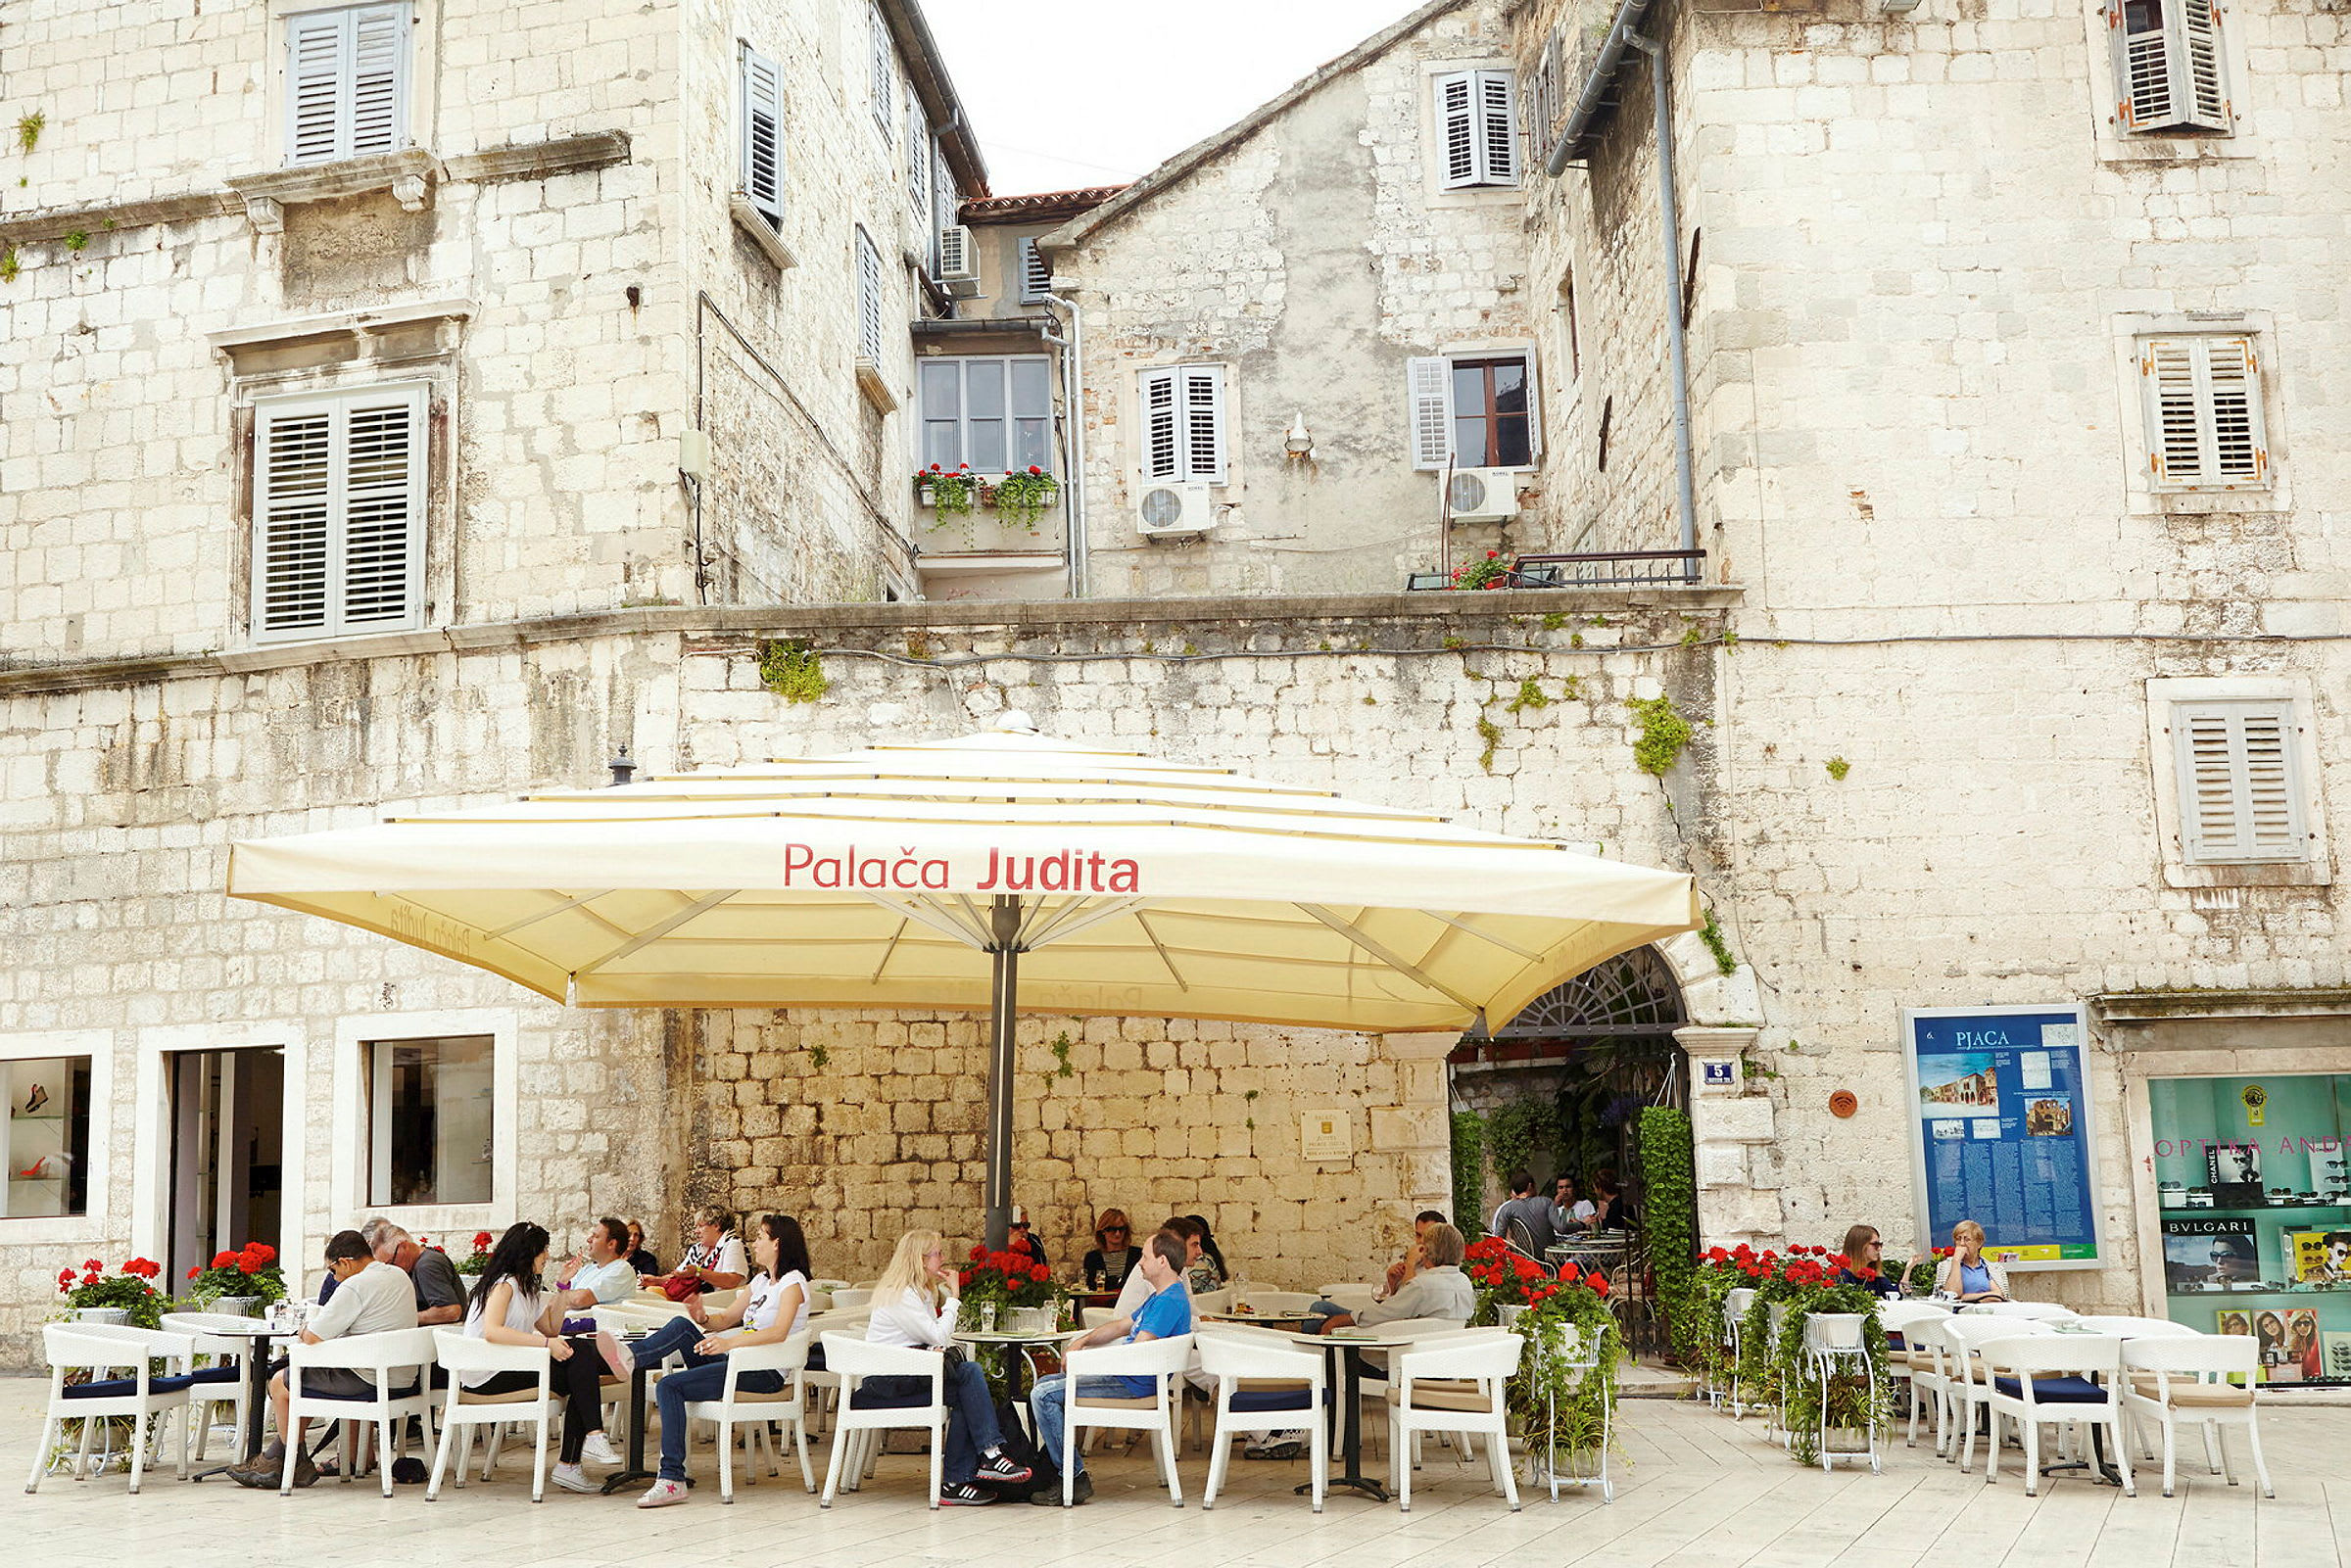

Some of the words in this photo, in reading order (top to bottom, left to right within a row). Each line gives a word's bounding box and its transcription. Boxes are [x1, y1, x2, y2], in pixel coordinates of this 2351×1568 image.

[784, 843, 949, 889] Palača
[976, 846, 1140, 893] Judita
[1955, 1030, 2010, 1051] PJACA
[1713, 1065, 1724, 1077] 5
[2155, 1136, 2262, 1158] OPTIKA
[2169, 1221, 2248, 1233] BVLGARI
